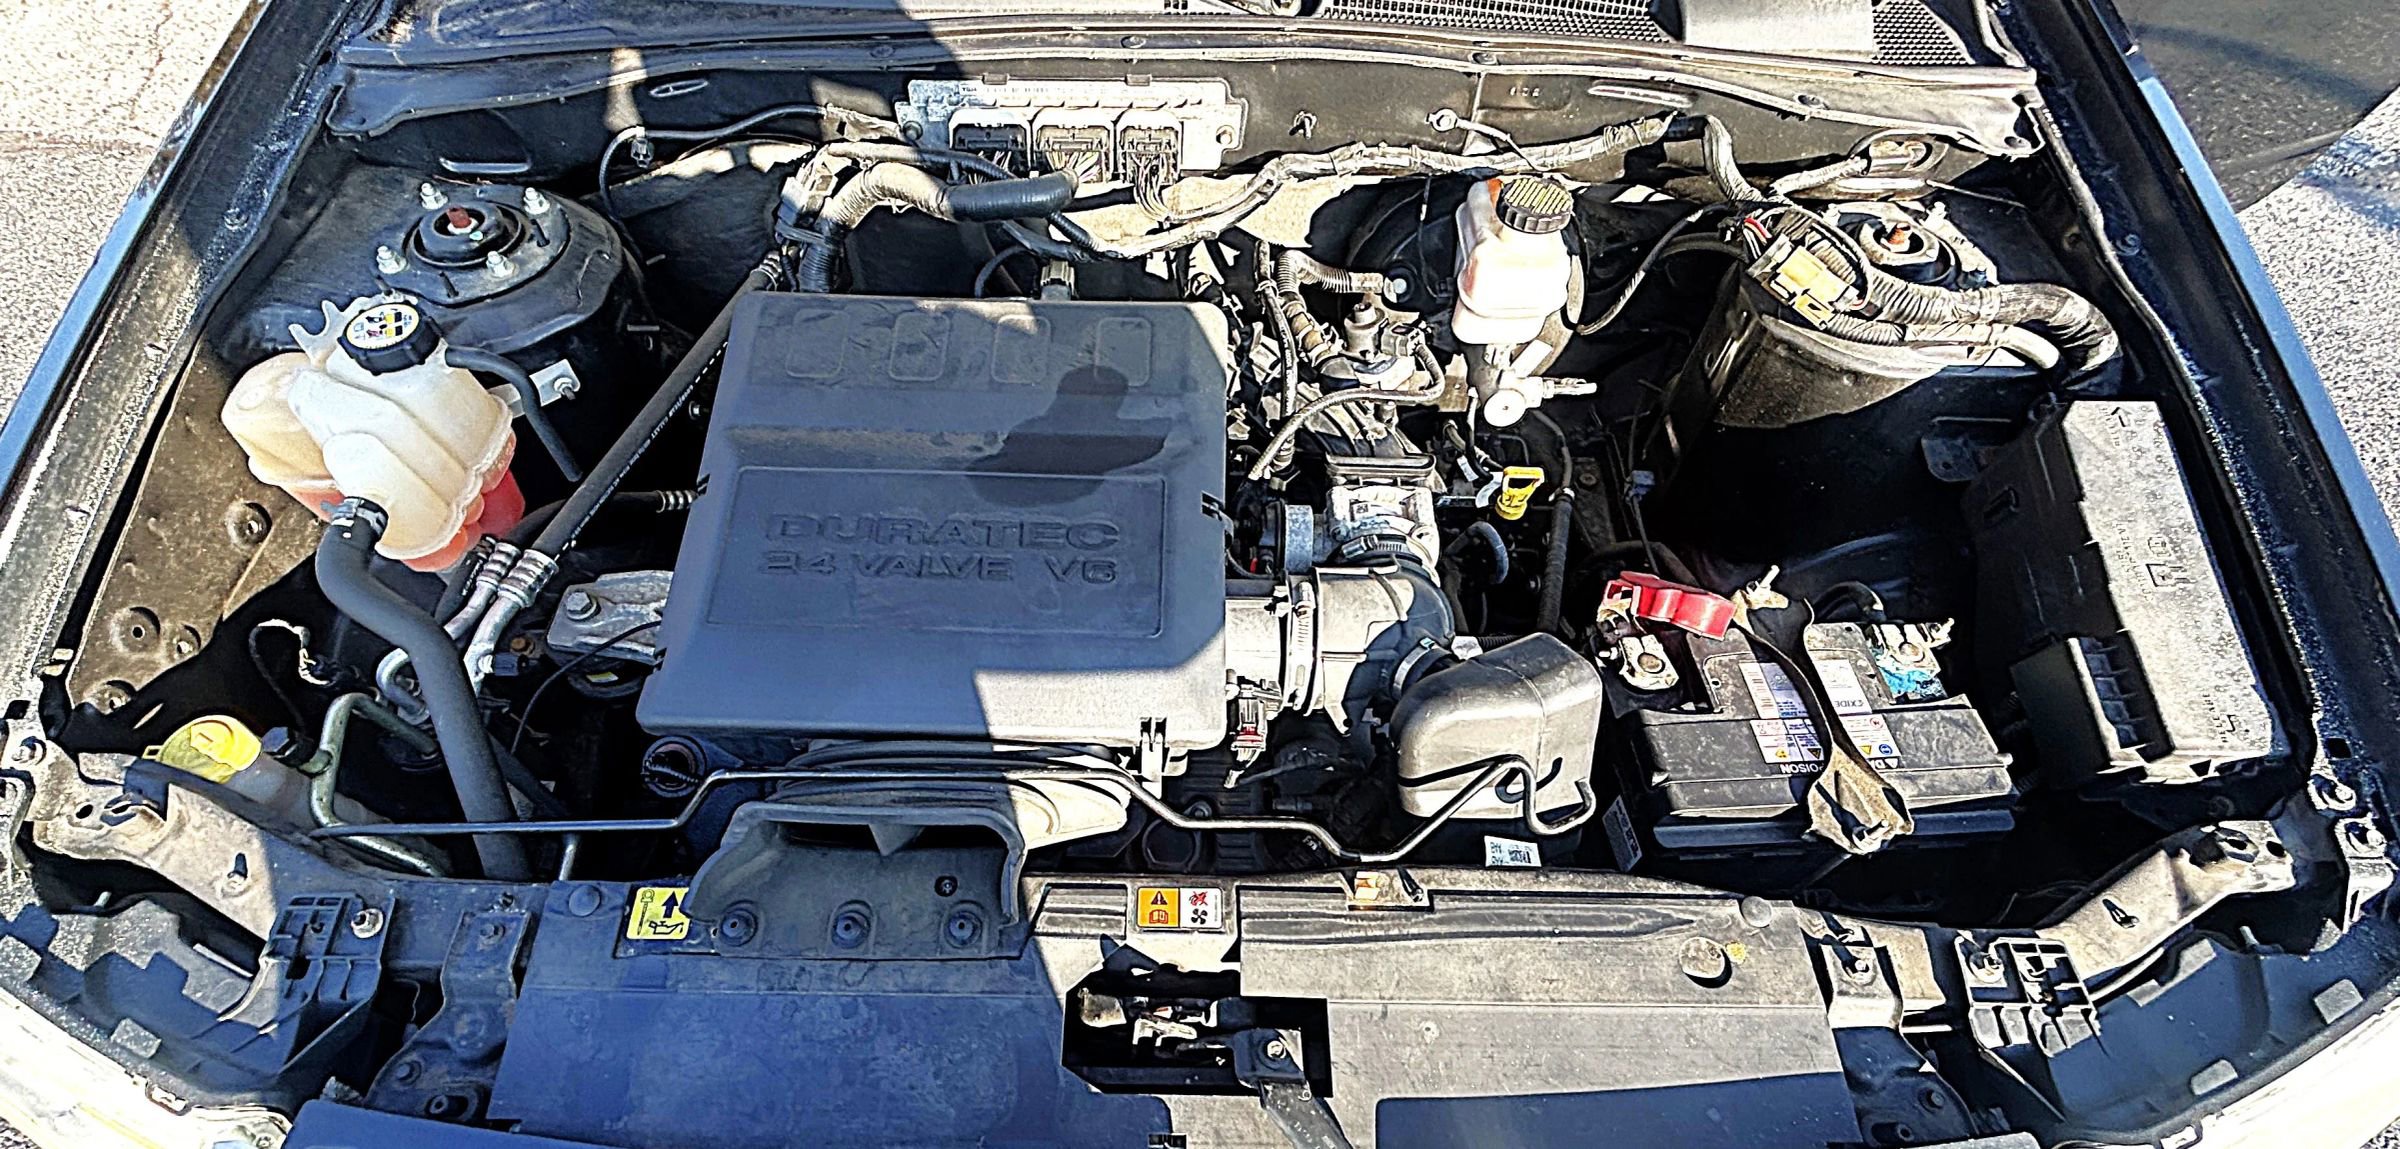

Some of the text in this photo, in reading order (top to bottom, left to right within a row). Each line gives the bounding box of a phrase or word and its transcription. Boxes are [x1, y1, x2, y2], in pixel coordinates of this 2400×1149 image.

[765, 512, 1121, 550] DURATEC
[760, 550, 1118, 584] 24 VALVE V6
